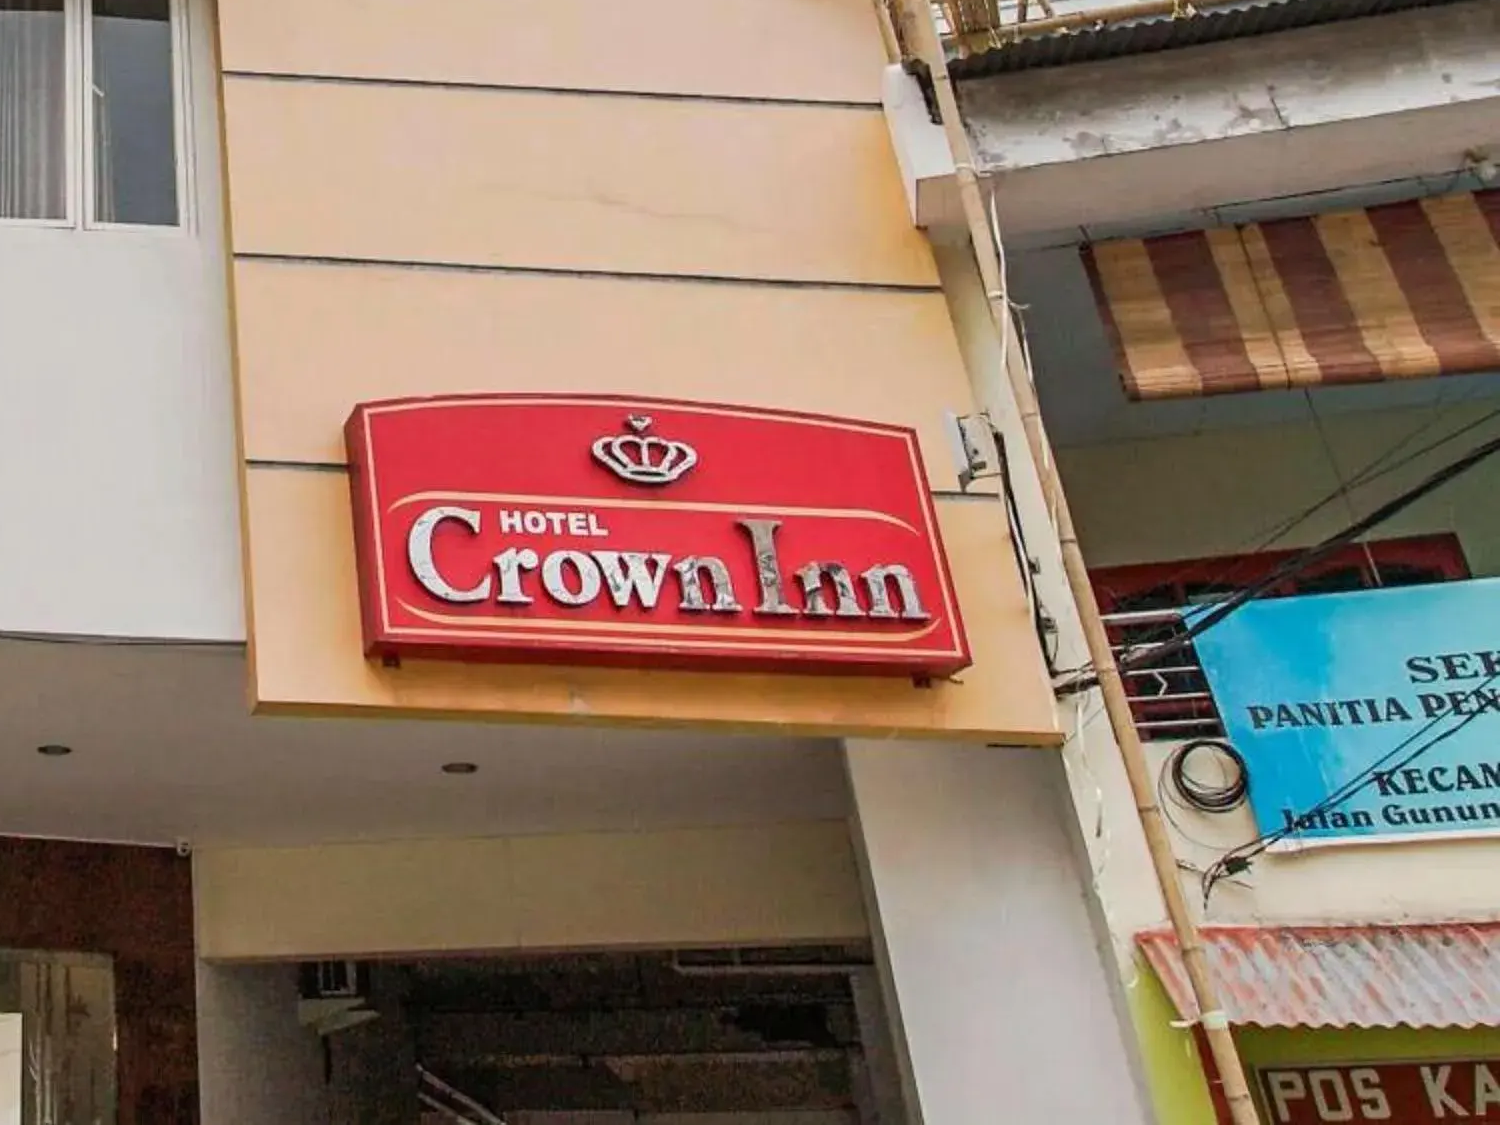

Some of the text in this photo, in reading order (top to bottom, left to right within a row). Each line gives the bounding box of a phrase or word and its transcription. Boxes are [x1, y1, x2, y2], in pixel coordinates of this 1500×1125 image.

[500, 509, 609, 537] HOTEL
[407, 506, 932, 620] Crown Inn
[1246, 696, 1413, 730] PANITIA
[1281, 804, 1374, 835] Jalan
[1267, 1068, 1392, 1123] POS
